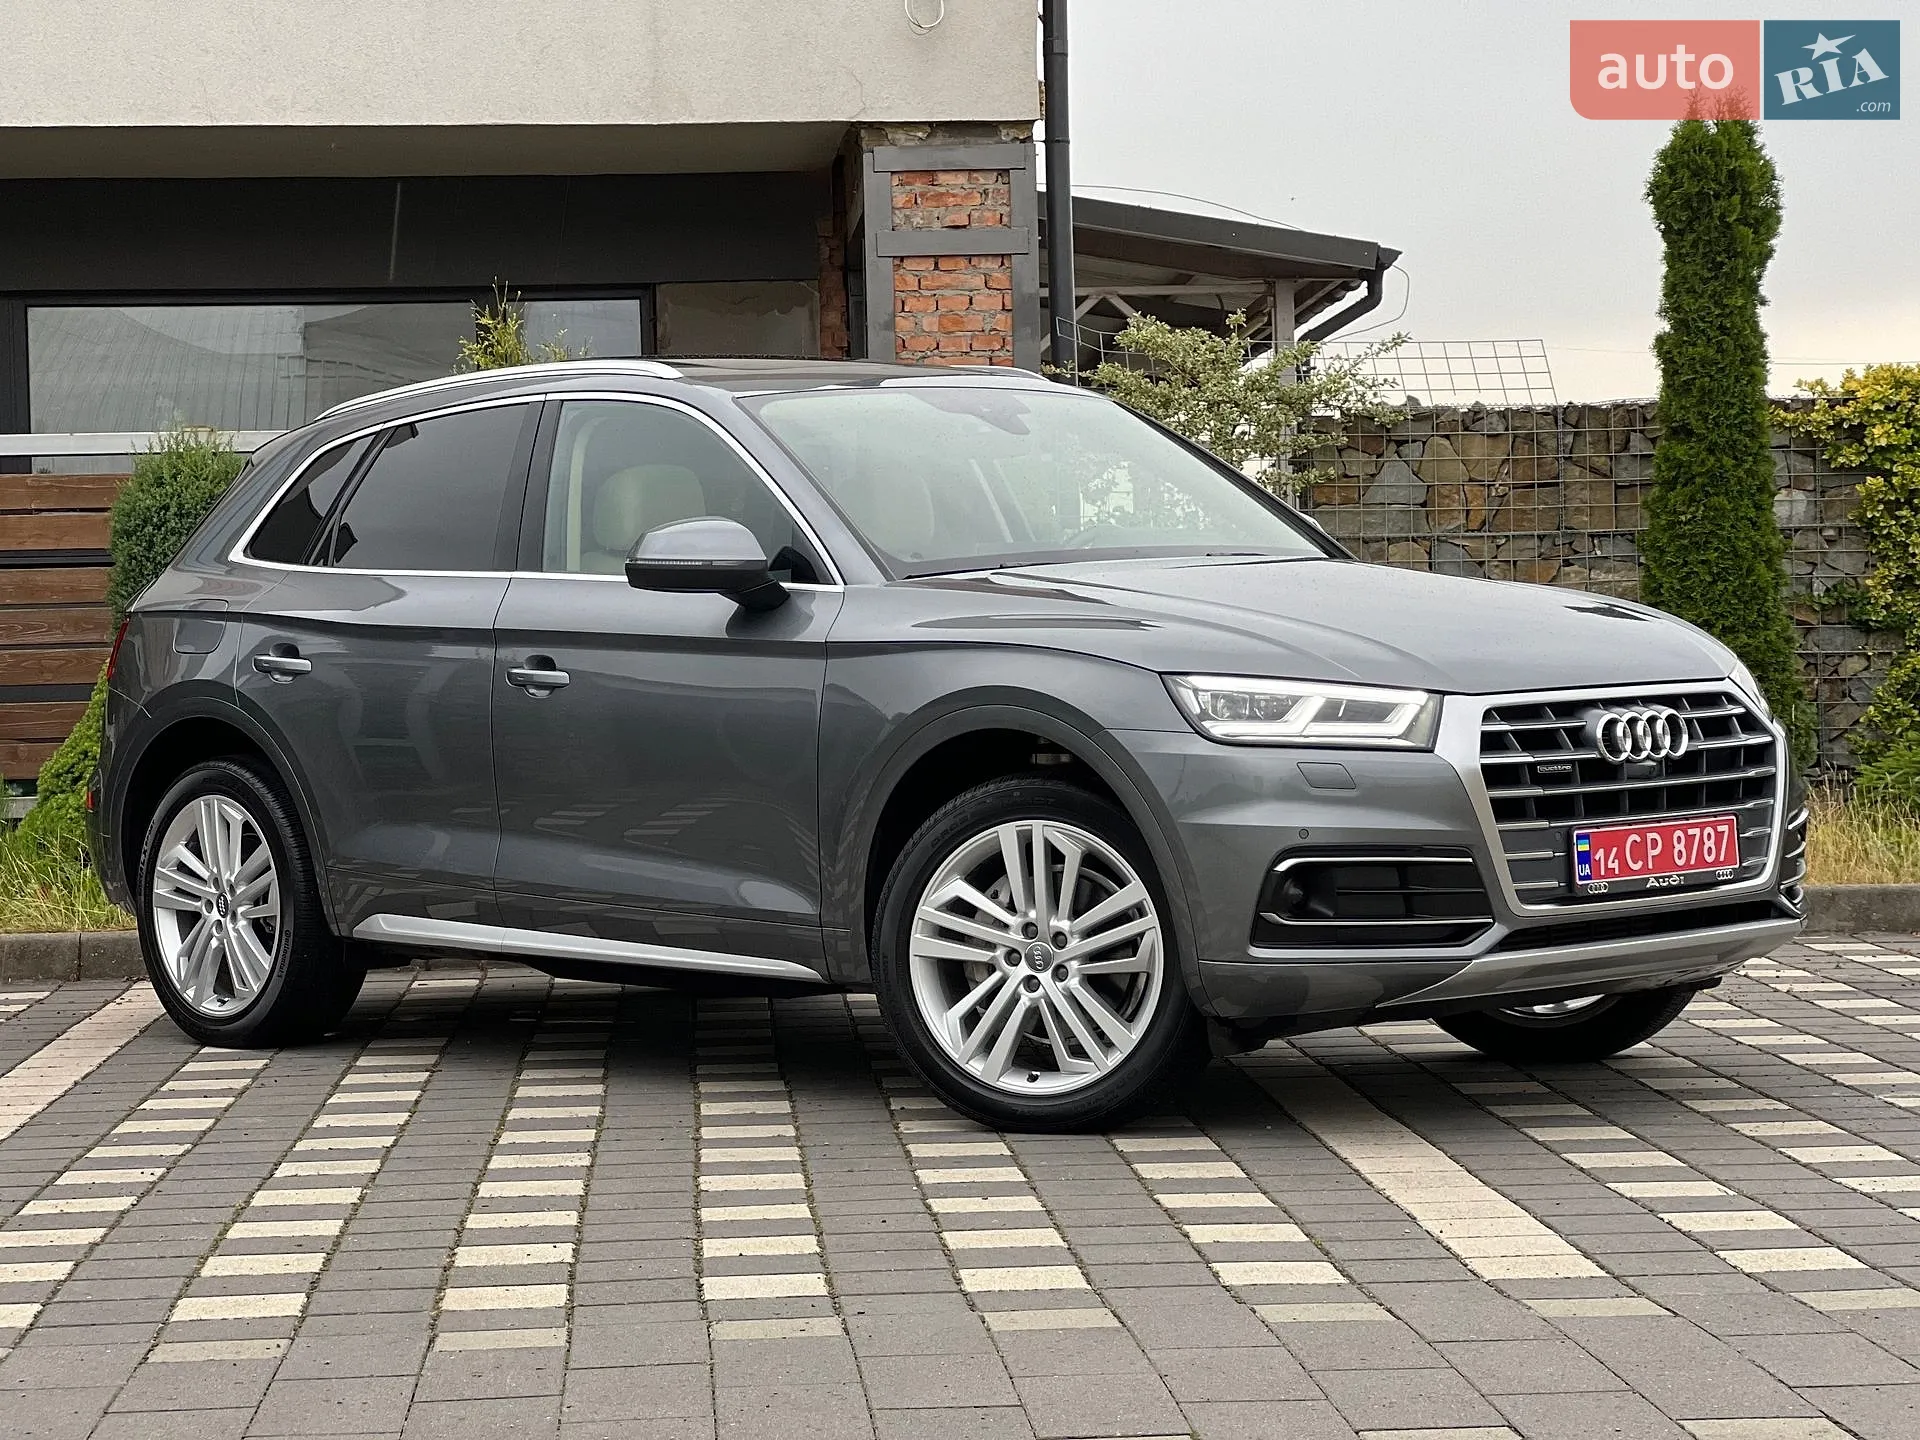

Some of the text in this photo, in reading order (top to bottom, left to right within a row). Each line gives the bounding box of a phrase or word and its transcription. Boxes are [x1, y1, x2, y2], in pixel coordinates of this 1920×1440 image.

[1672, 825, 1730, 866] 8787
[1578, 864, 1591, 876] UA
[1646, 875, 1685, 888] Audi
